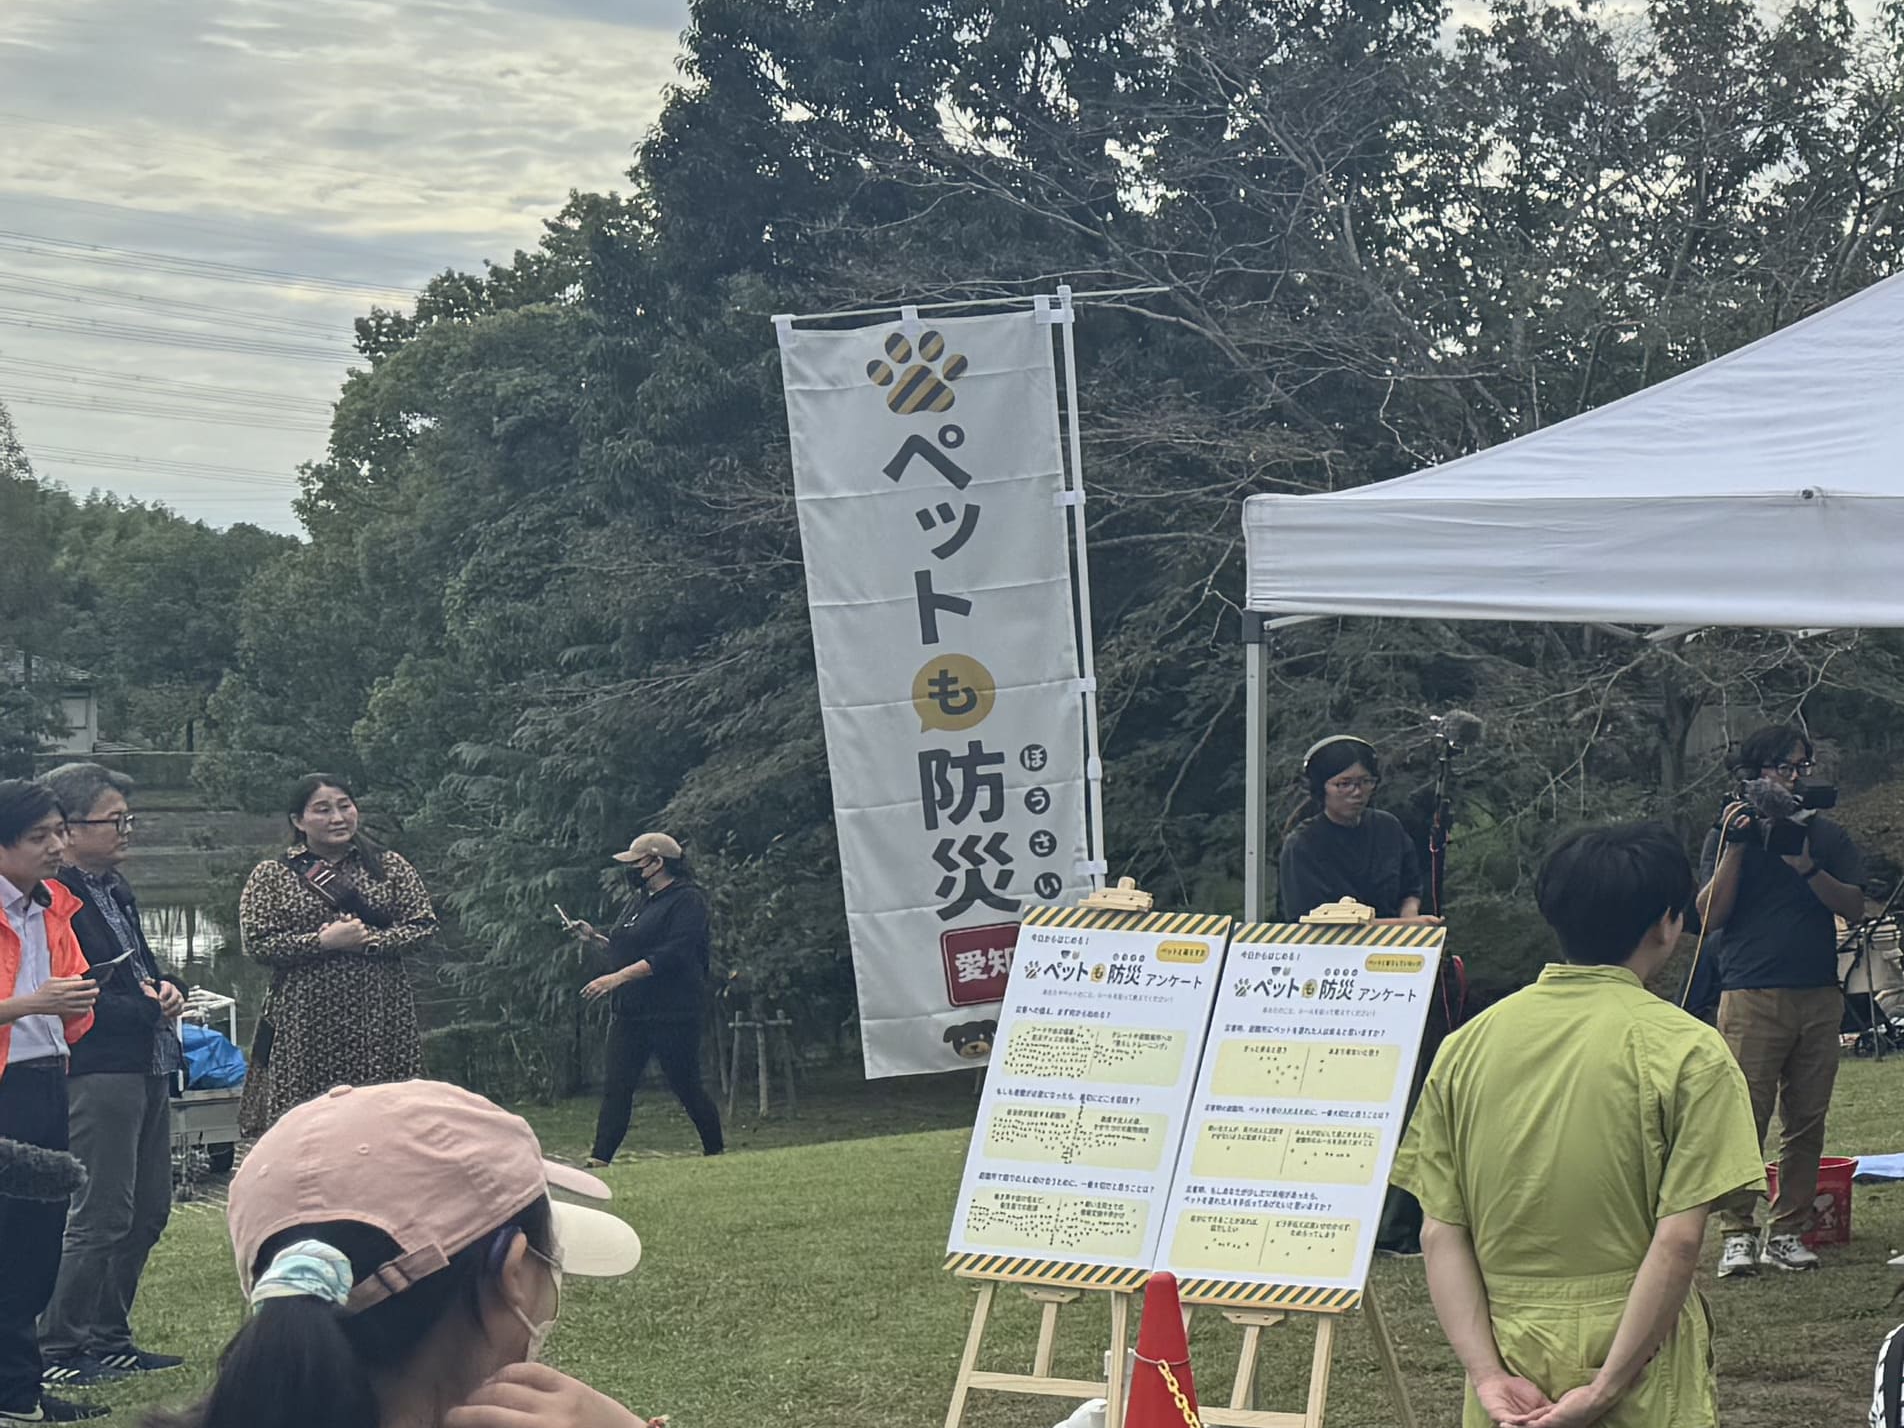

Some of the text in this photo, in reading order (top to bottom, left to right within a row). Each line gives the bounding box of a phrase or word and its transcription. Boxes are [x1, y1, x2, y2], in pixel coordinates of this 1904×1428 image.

[883, 424, 1021, 921] ペットも防災
[1022, 746, 1061, 897] ほうさい
[1044, 961, 1203, 990] ペットも防災 アンケート
[1253, 977, 1417, 1003] ペットも防災 アンケート
